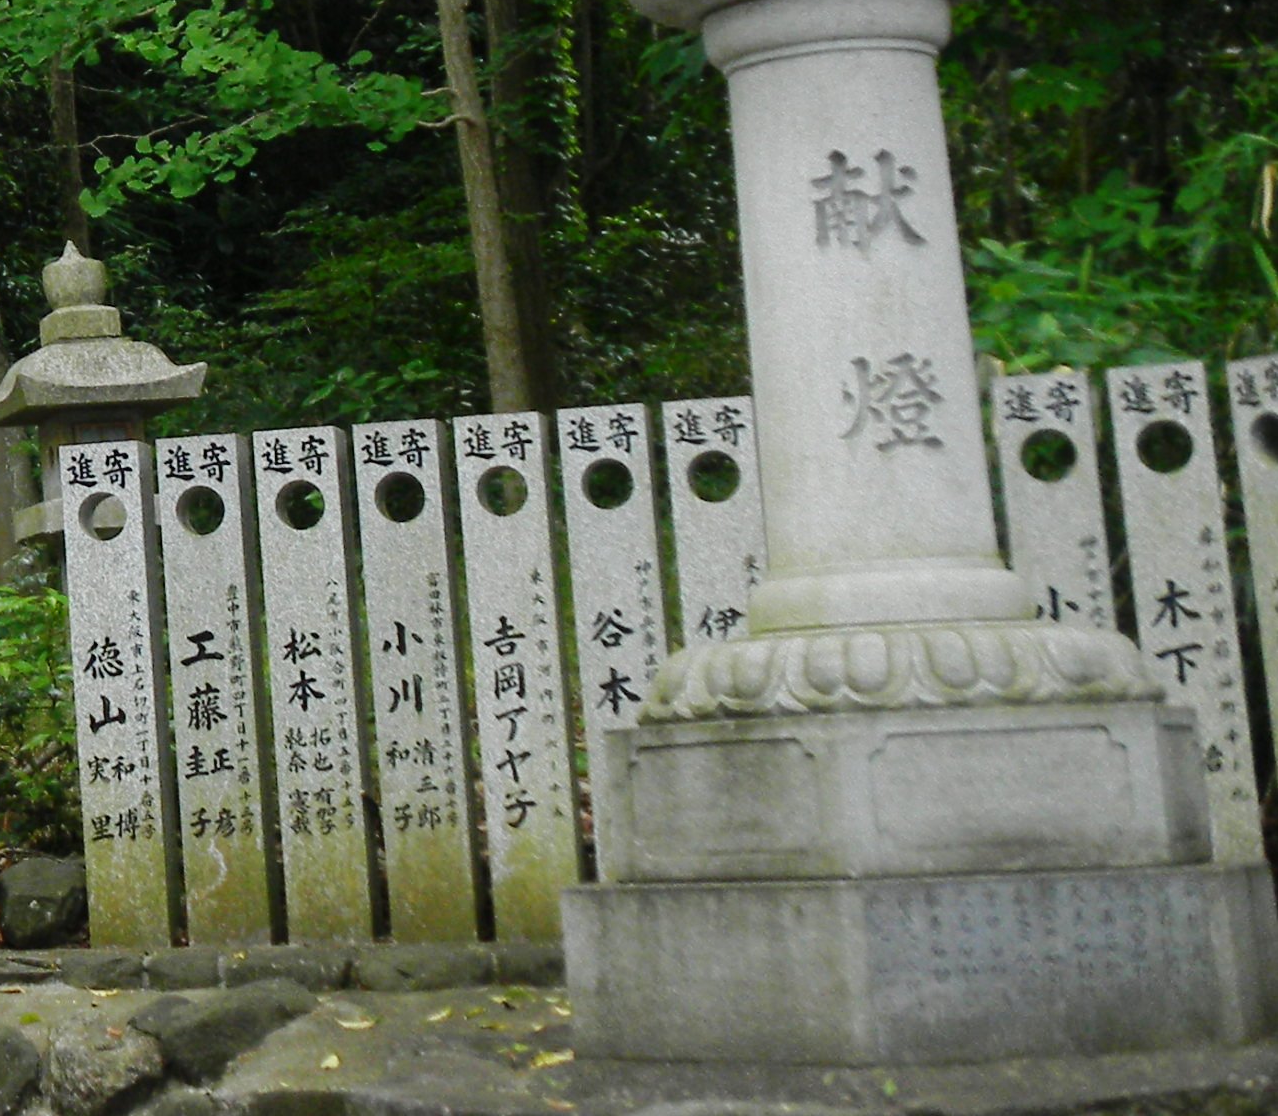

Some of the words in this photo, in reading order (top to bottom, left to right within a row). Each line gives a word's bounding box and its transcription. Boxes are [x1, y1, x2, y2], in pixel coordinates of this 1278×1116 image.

[567, 412, 639, 453] 寄進
[673, 404, 746, 448] 寄進
[1004, 380, 1081, 424] 寄進
[1121, 369, 1199, 415] 寄進
[67, 448, 134, 490] 寄進
[163, 441, 232, 484] 寄進
[261, 434, 330, 476] 寄進
[361, 427, 431, 469] 寄進
[463, 420, 533, 462] 寄進
[283, 627, 326, 713] 松本
[382, 620, 424, 714] 小川
[591, 607, 642, 716] 谷本
[1151, 579, 1203, 685] 木下
[83, 636, 127, 734] 徳山
[181, 629, 229, 732] 工藤
[111, 755, 141, 841] 和博
[184, 744, 212, 839] 圭子
[210, 747, 238, 839] 正彦
[386, 740, 414, 833] 和子
[413, 737, 442, 831] 清三郎
